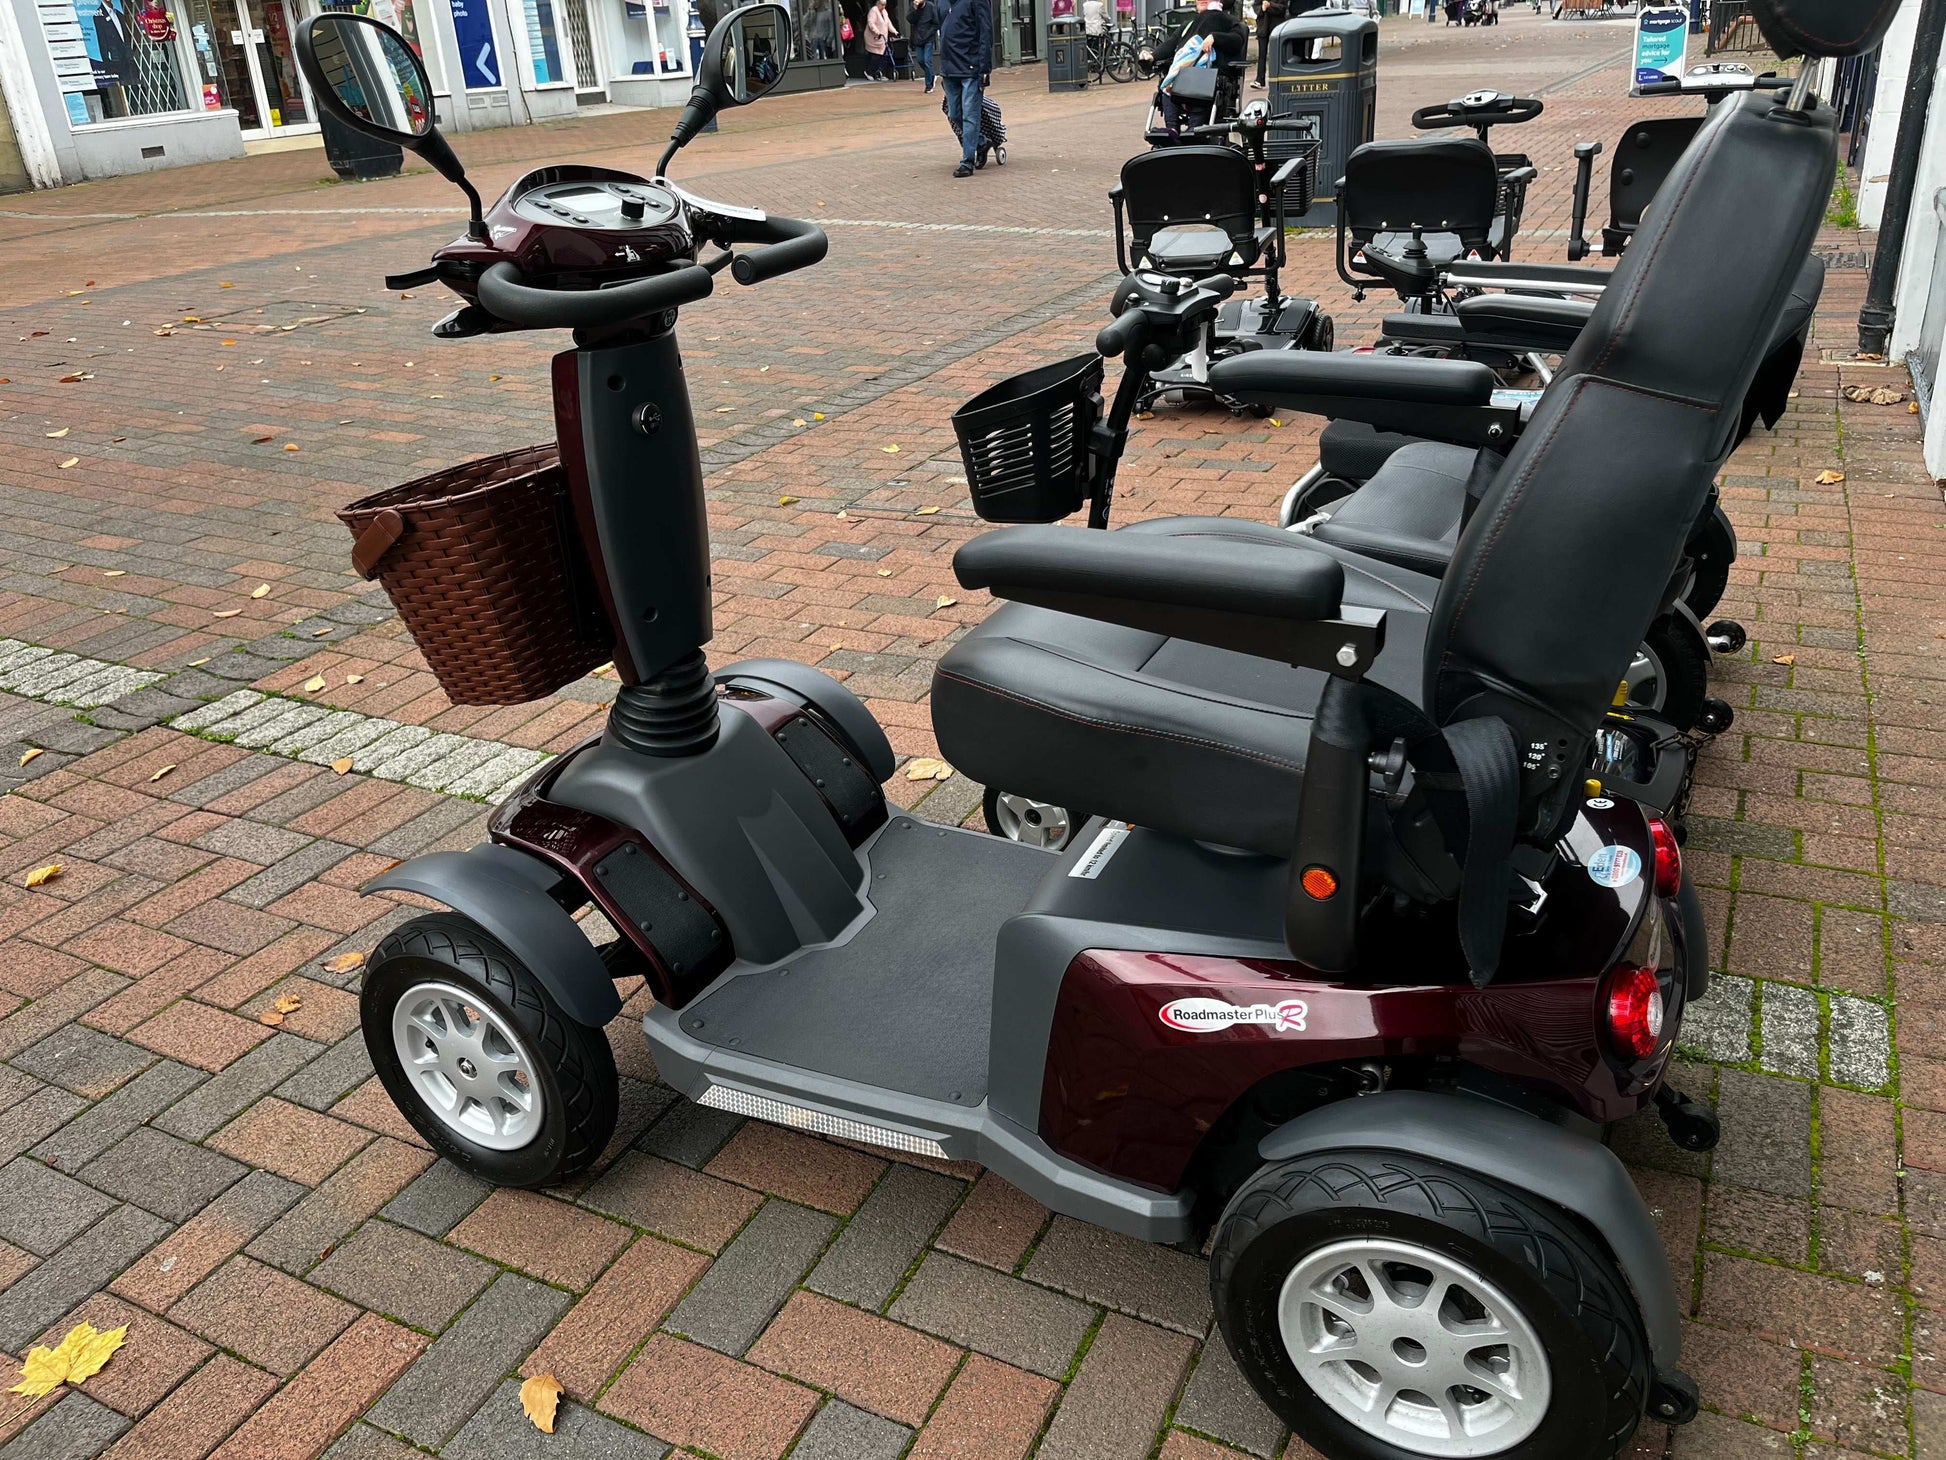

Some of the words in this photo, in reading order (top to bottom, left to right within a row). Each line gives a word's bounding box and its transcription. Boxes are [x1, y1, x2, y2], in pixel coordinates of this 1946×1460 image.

[452, 0, 464, 9] baby
[454, 10, 468, 18] photo
[1291, 83, 1329, 92] LITTER
[1530, 742, 1548, 750] 135°
[1527, 752, 1546, 761] 120°
[1592, 853, 1608, 872] Eden
[1173, 1009, 1253, 1021] Roadmaster
